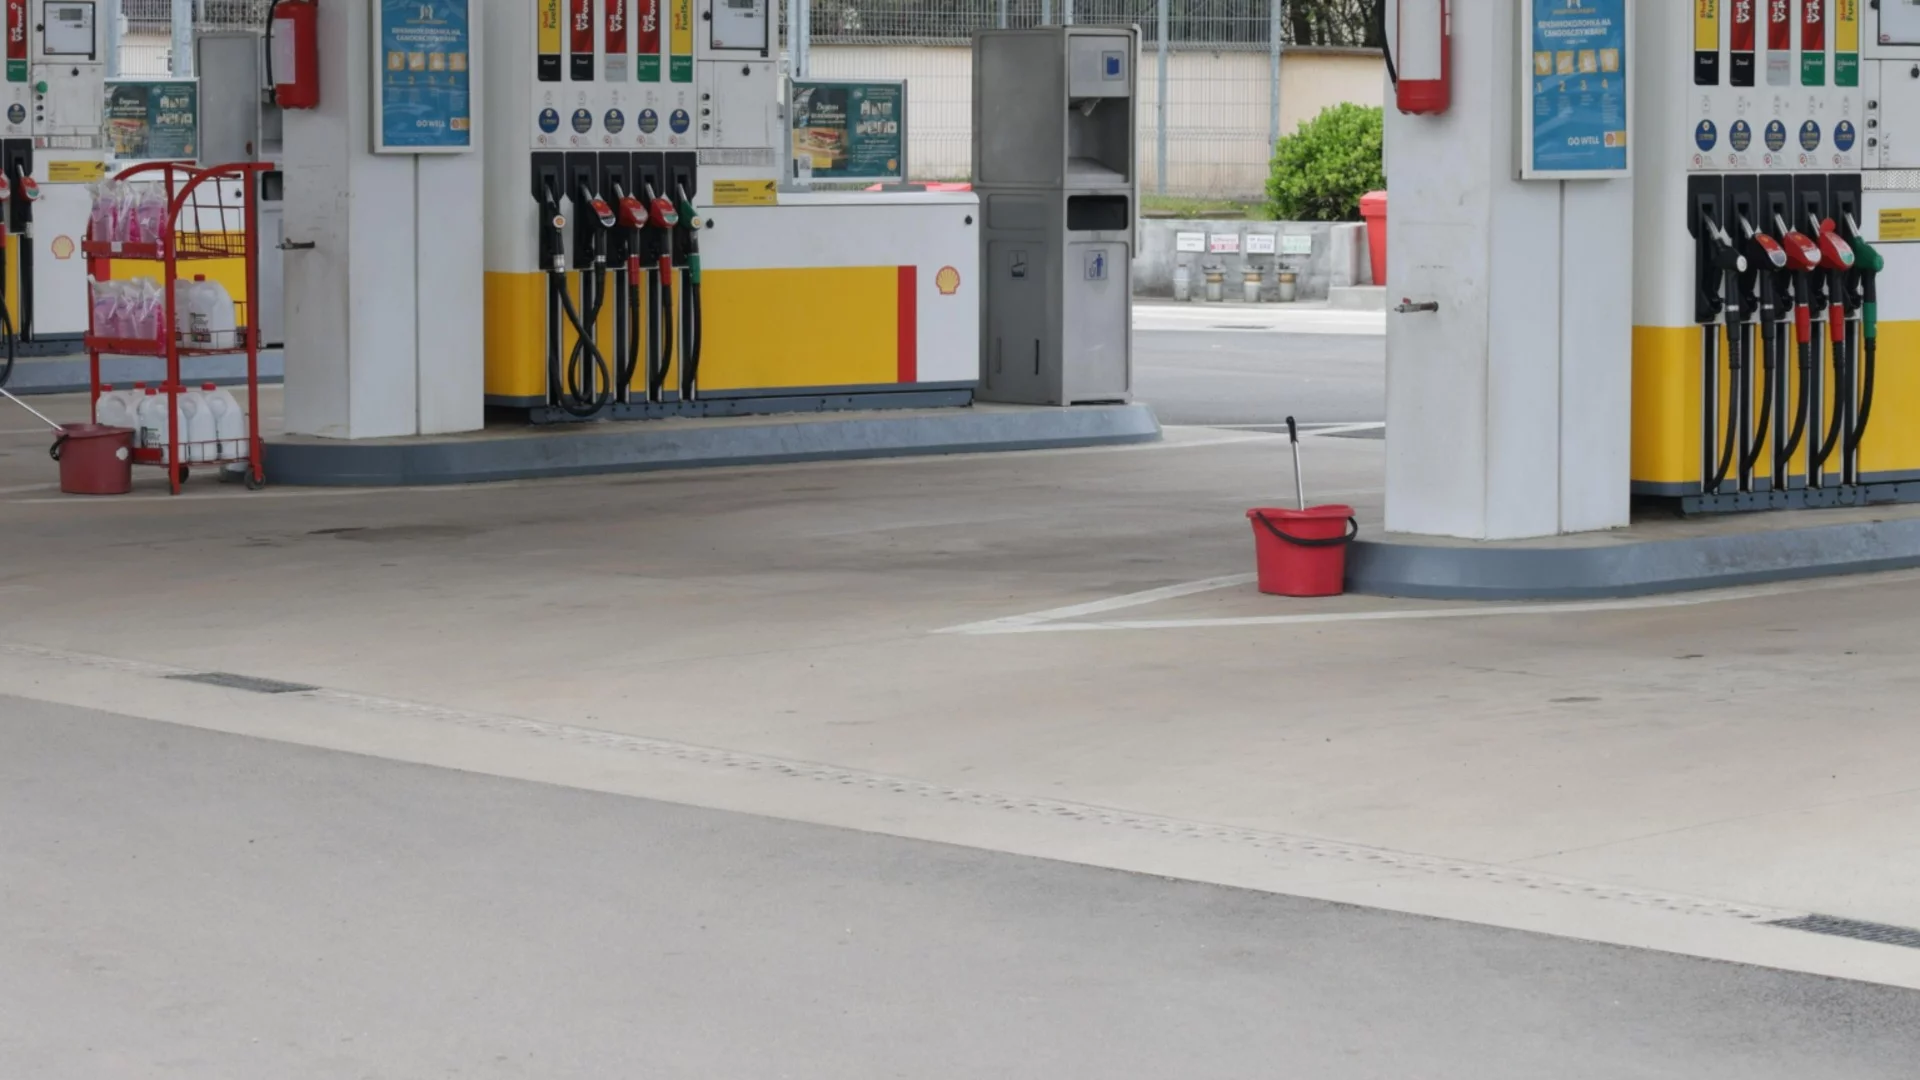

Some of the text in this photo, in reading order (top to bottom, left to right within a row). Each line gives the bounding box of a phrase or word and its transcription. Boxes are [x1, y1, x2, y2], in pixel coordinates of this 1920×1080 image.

[1536, 78, 1608, 93] 1 2 3 4
[416, 119, 428, 127] GO
[1567, 135, 1600, 146] GO WELL
